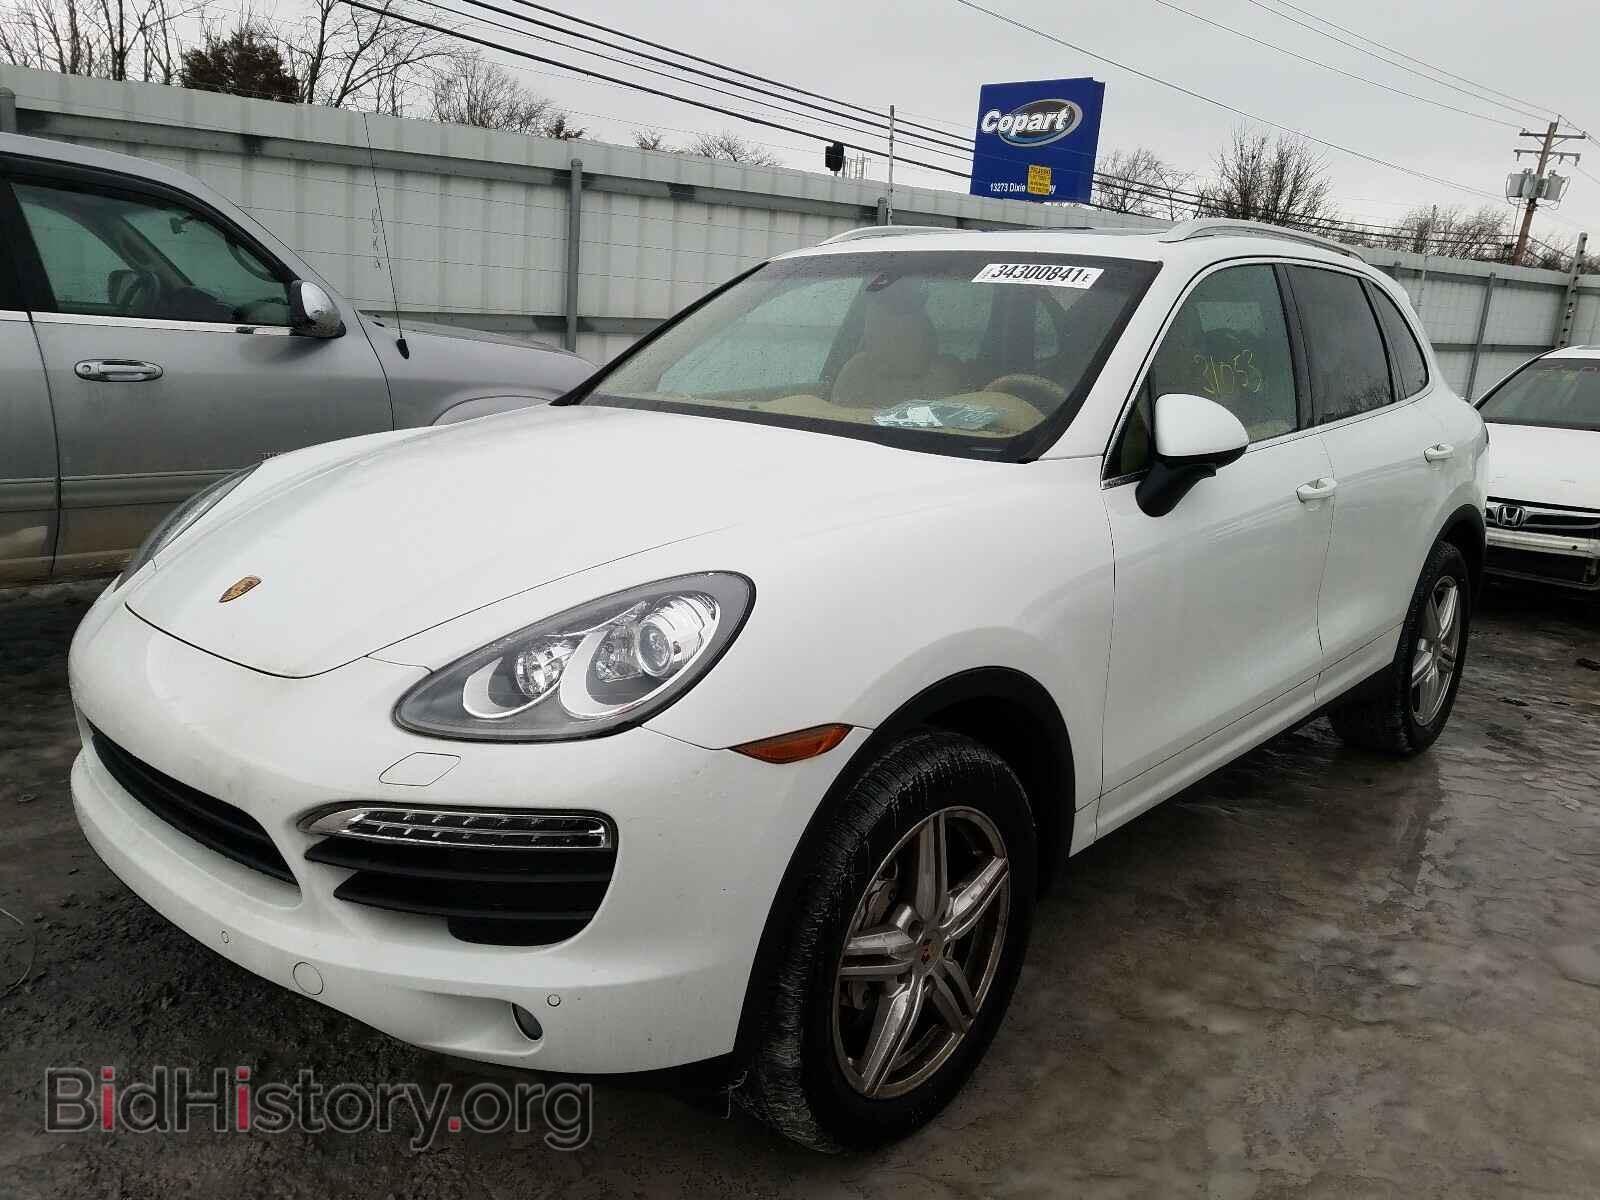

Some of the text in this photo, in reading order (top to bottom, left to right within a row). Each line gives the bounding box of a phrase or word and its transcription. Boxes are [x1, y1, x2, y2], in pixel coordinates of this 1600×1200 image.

[981, 105, 1070, 137] Copart
[990, 183, 1026, 192] 13273 Dixie
[992, 264, 1085, 282] 34300841
